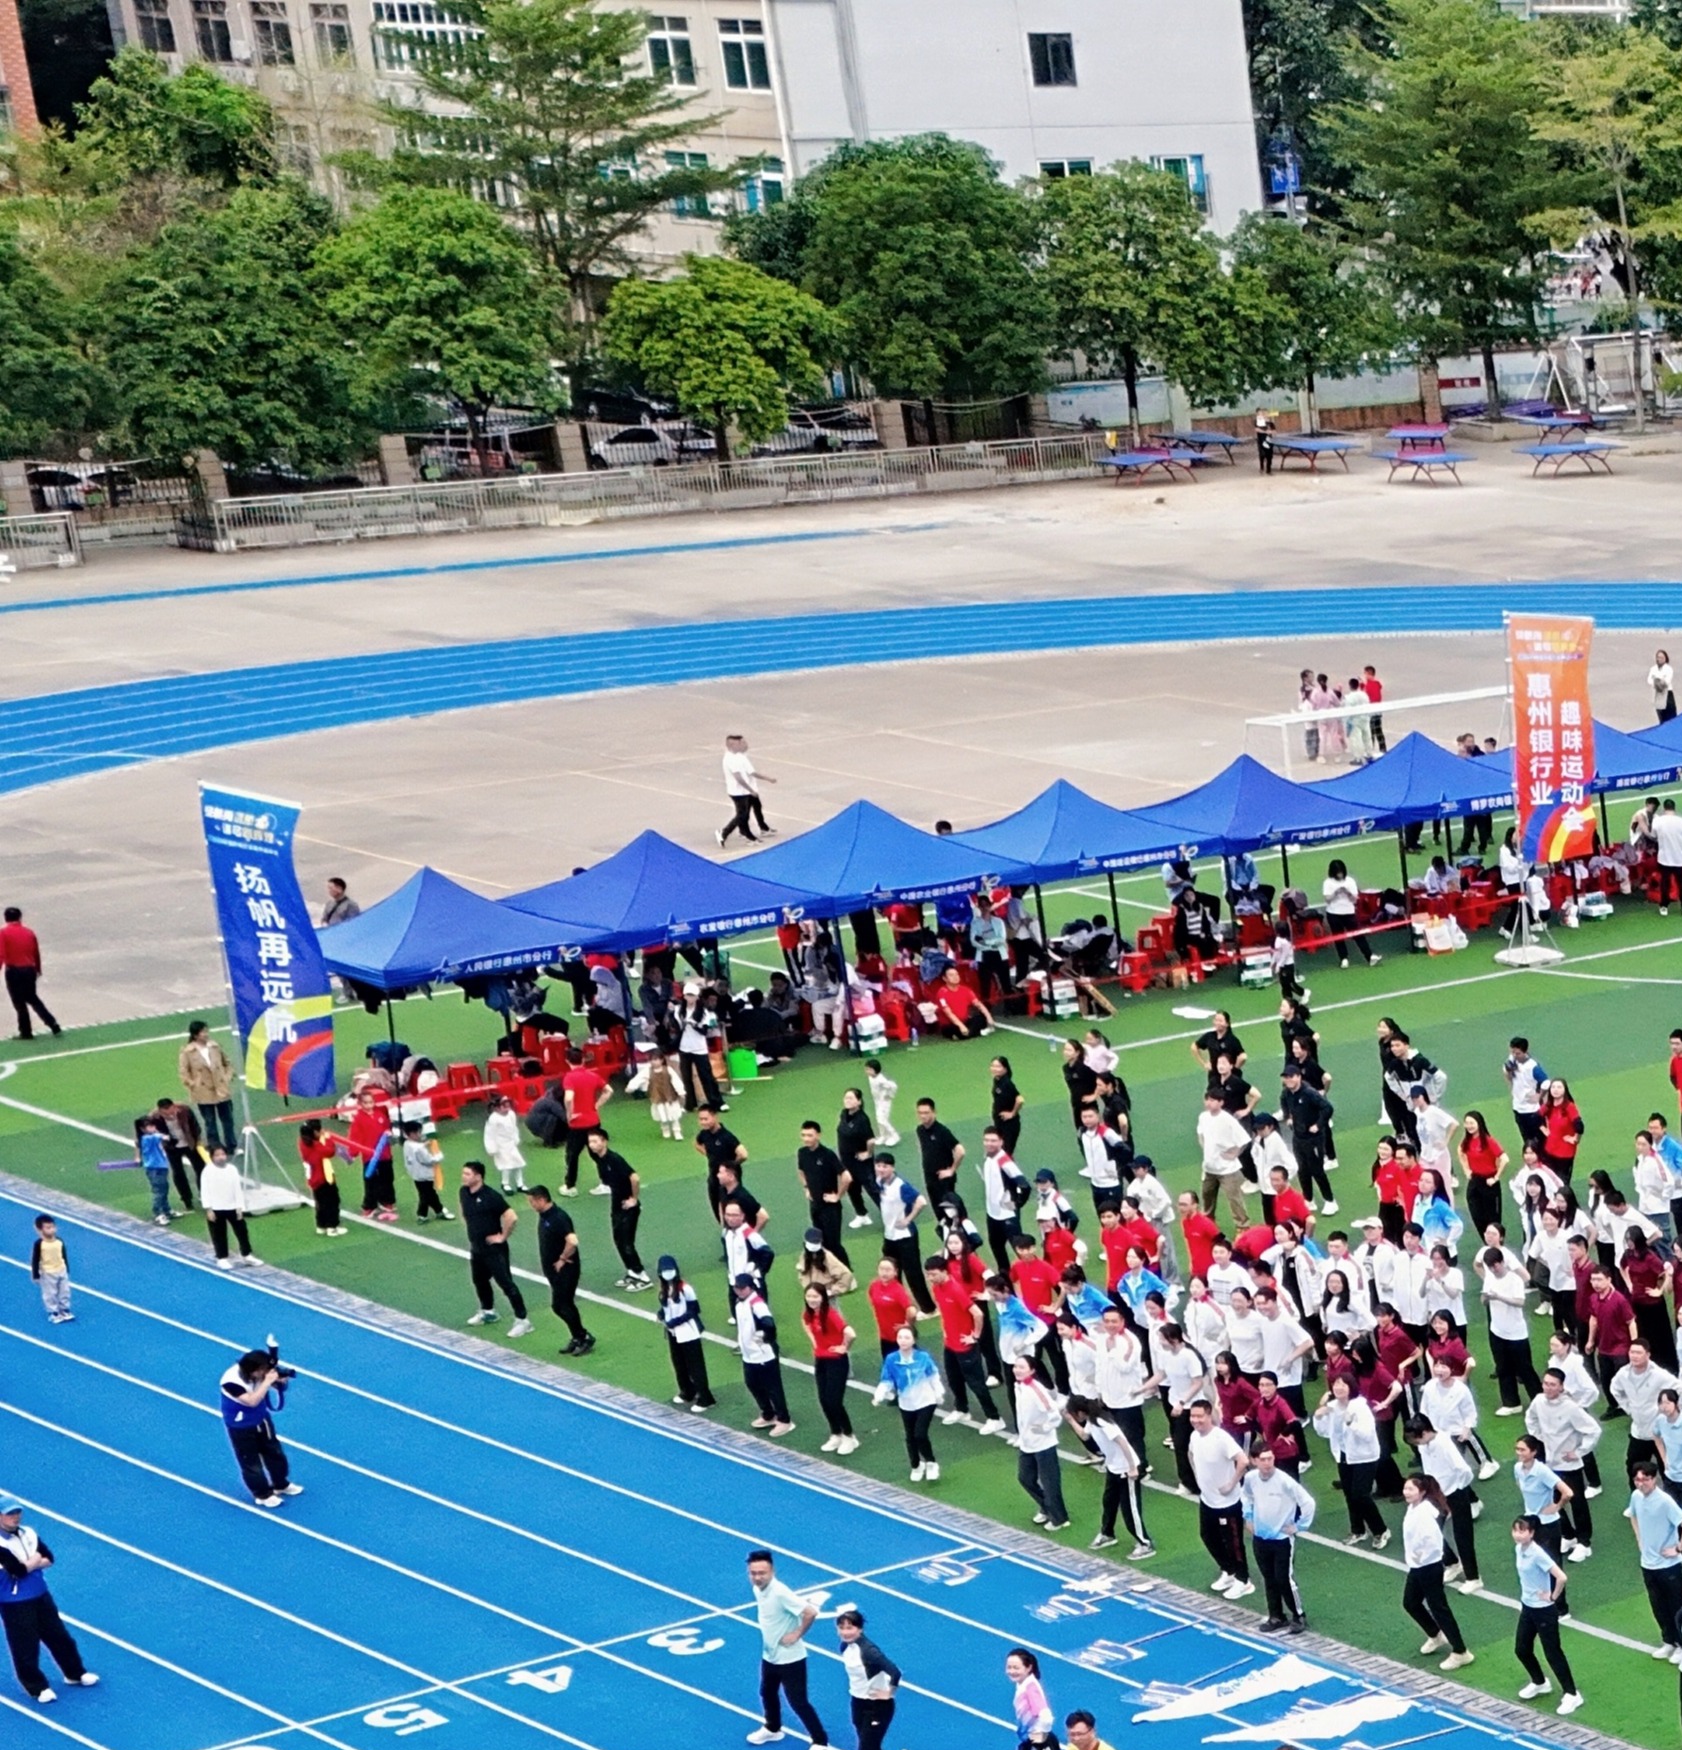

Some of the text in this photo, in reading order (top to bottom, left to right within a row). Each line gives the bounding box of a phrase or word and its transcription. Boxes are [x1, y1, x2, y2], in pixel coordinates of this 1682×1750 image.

[1527, 673, 1554, 805] 惠州银行业
[1560, 701, 1585, 831] 趣味运动会
[233, 862, 297, 1044] 扬帆再远航
[505, 1665, 573, 1694] 4
[647, 1627, 726, 1656] 3
[363, 1703, 450, 1736] 5
